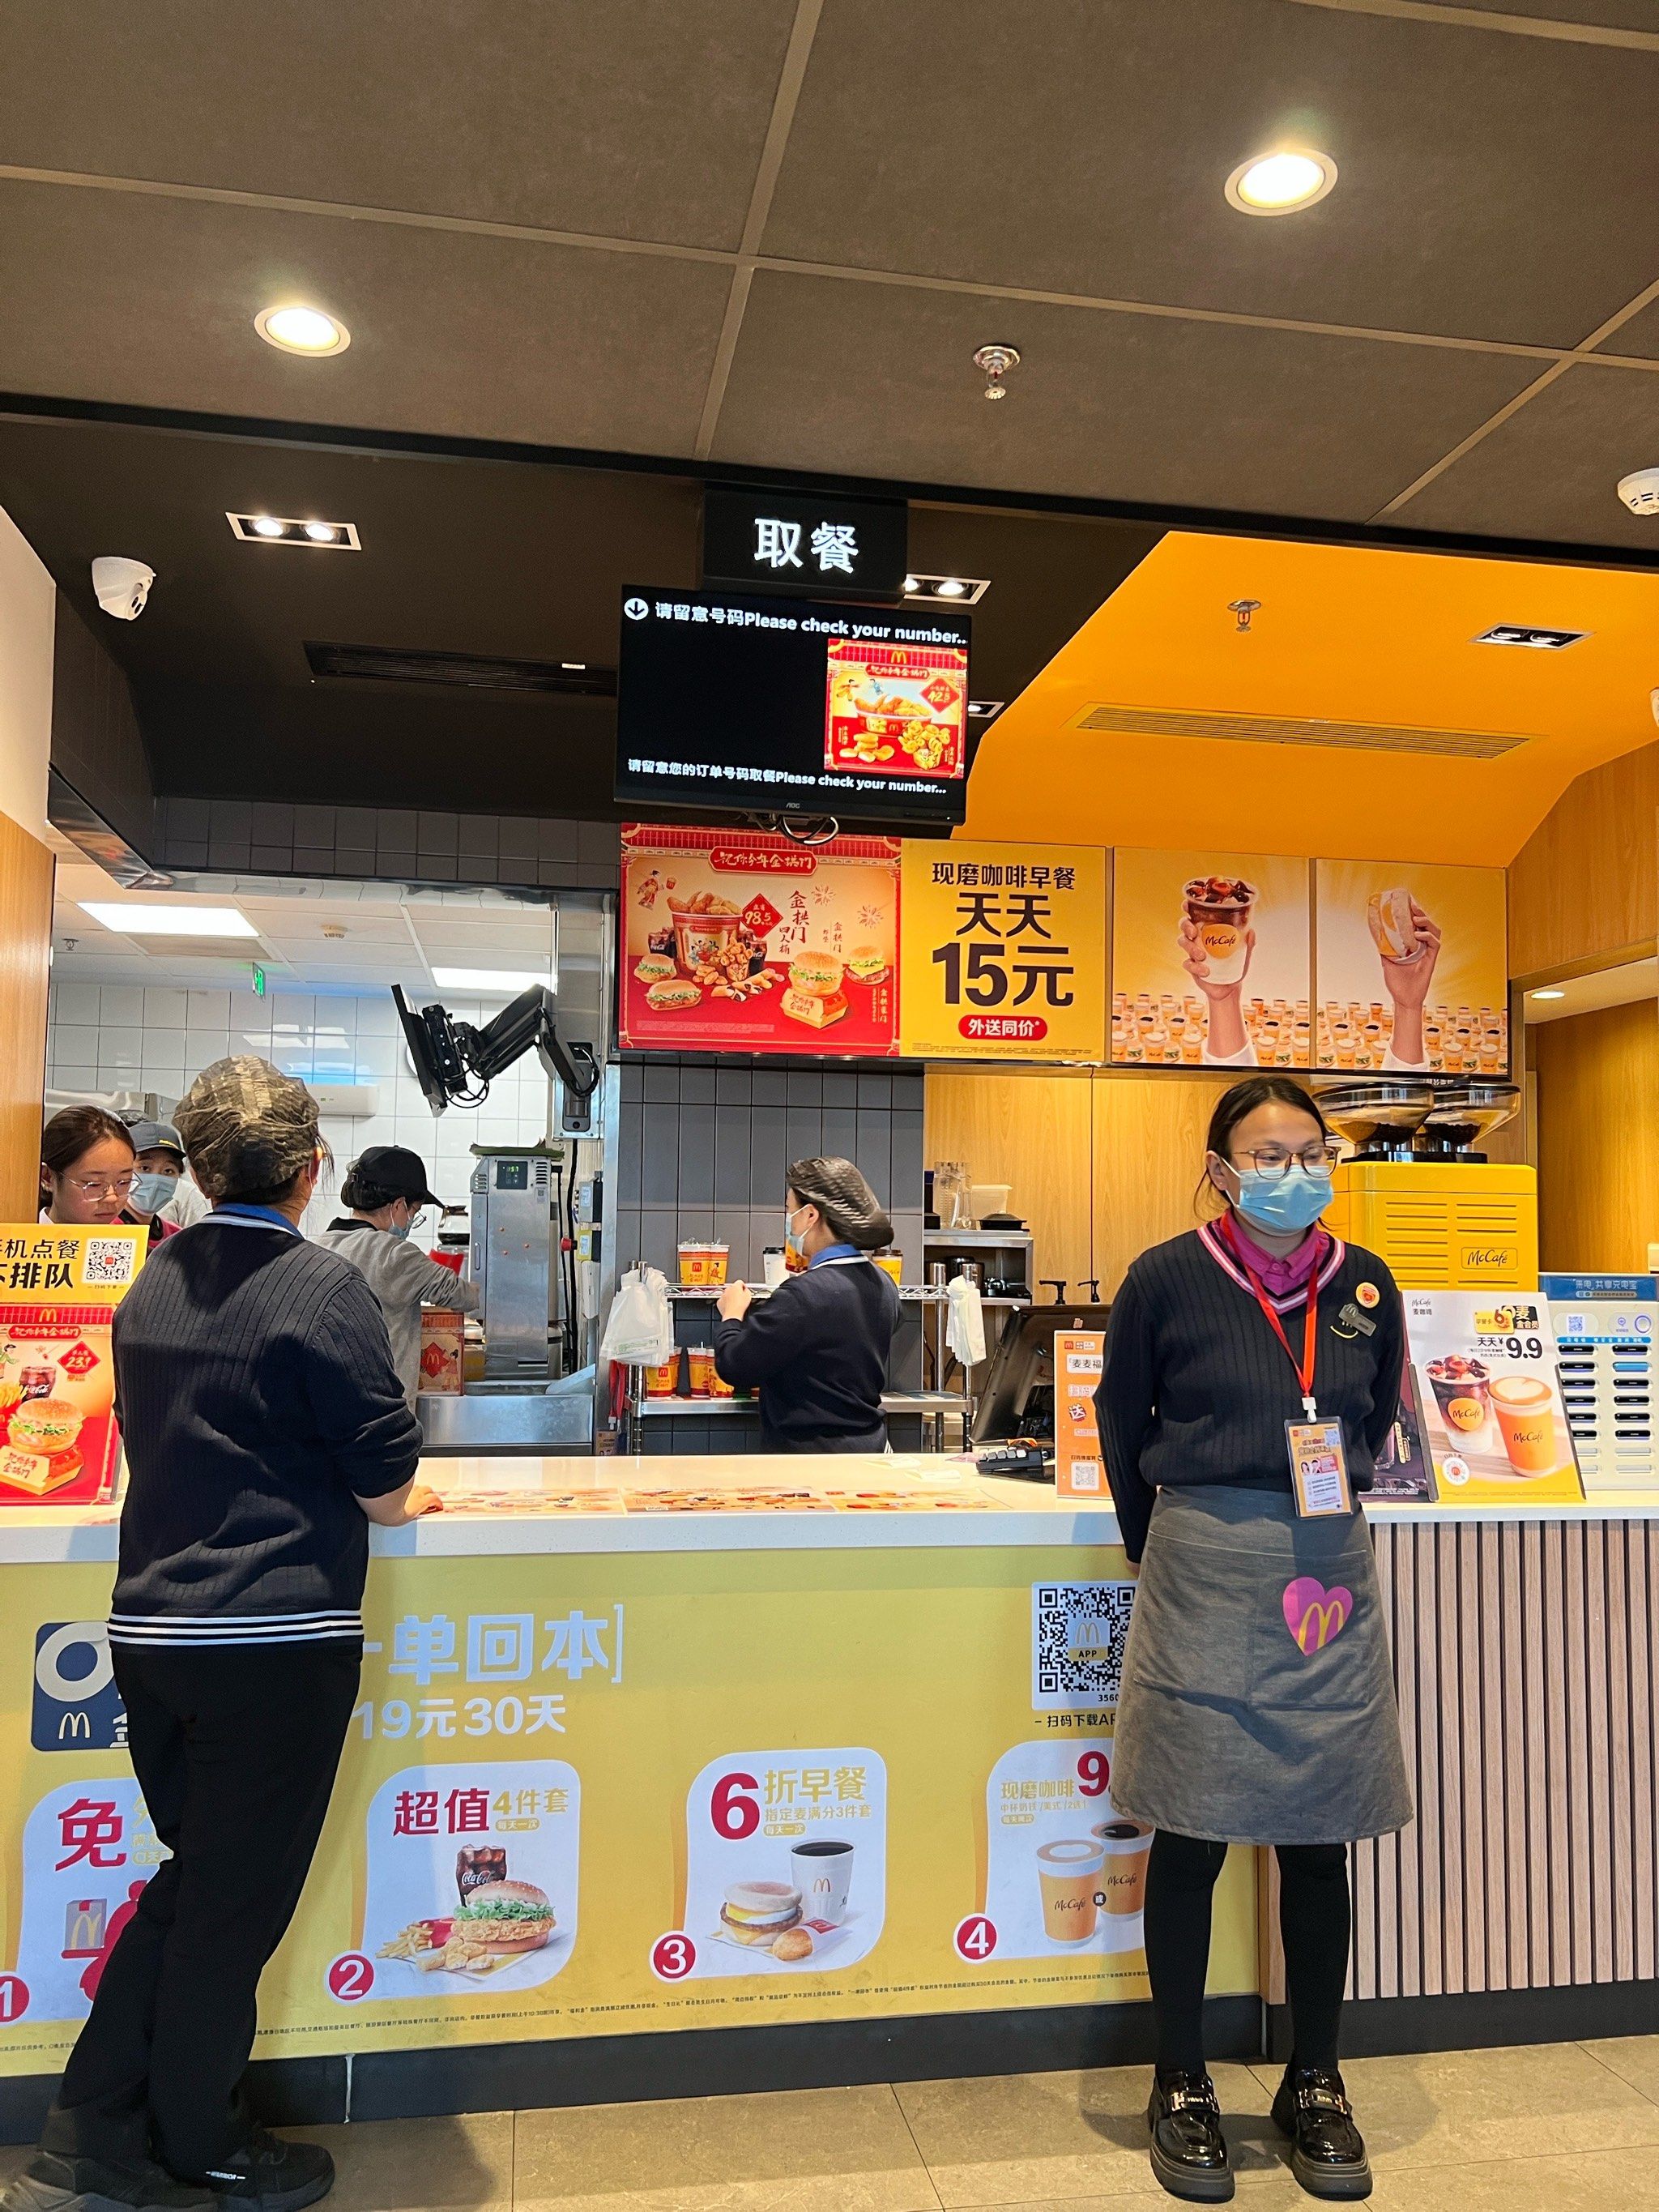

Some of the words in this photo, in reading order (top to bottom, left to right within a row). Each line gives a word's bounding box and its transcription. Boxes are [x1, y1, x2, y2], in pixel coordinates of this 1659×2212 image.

[754, 518, 859, 574] 取餐
[800, 617, 849, 634] check
[852, 622, 891, 639] your
[818, 774, 854, 788] check
[856, 779, 885, 791] your
[932, 862, 1076, 890] 现磨咖啡早餐
[788, 890, 810, 944] 金拱门
[956, 891, 1051, 939] 天天
[1205, 933, 1237, 947] McCafé
[932, 942, 1074, 1007] 15元
[0, 1239, 79, 1260] 机点餐
[1467, 1249, 1508, 1267] McCafé
[1078, 1650, 1098, 1658] APP
[763, 1766, 867, 1805] 折早餐
[1001, 1779, 1074, 1800] 现磨咖啡
[393, 1787, 490, 1837] 超值
[493, 1788, 569, 1815] 4件套
[710, 1773, 761, 1840] 6
[765, 1804, 872, 1823] 指定麦满分3件套
[55, 1798, 127, 1872] 免
[1107, 1873, 1137, 1886] McCafé
[1054, 1897, 1086, 1911] McCafé
[964, 1921, 990, 1955] 4
[662, 1938, 686, 1975] 3
[338, 1959, 364, 1996] 2
